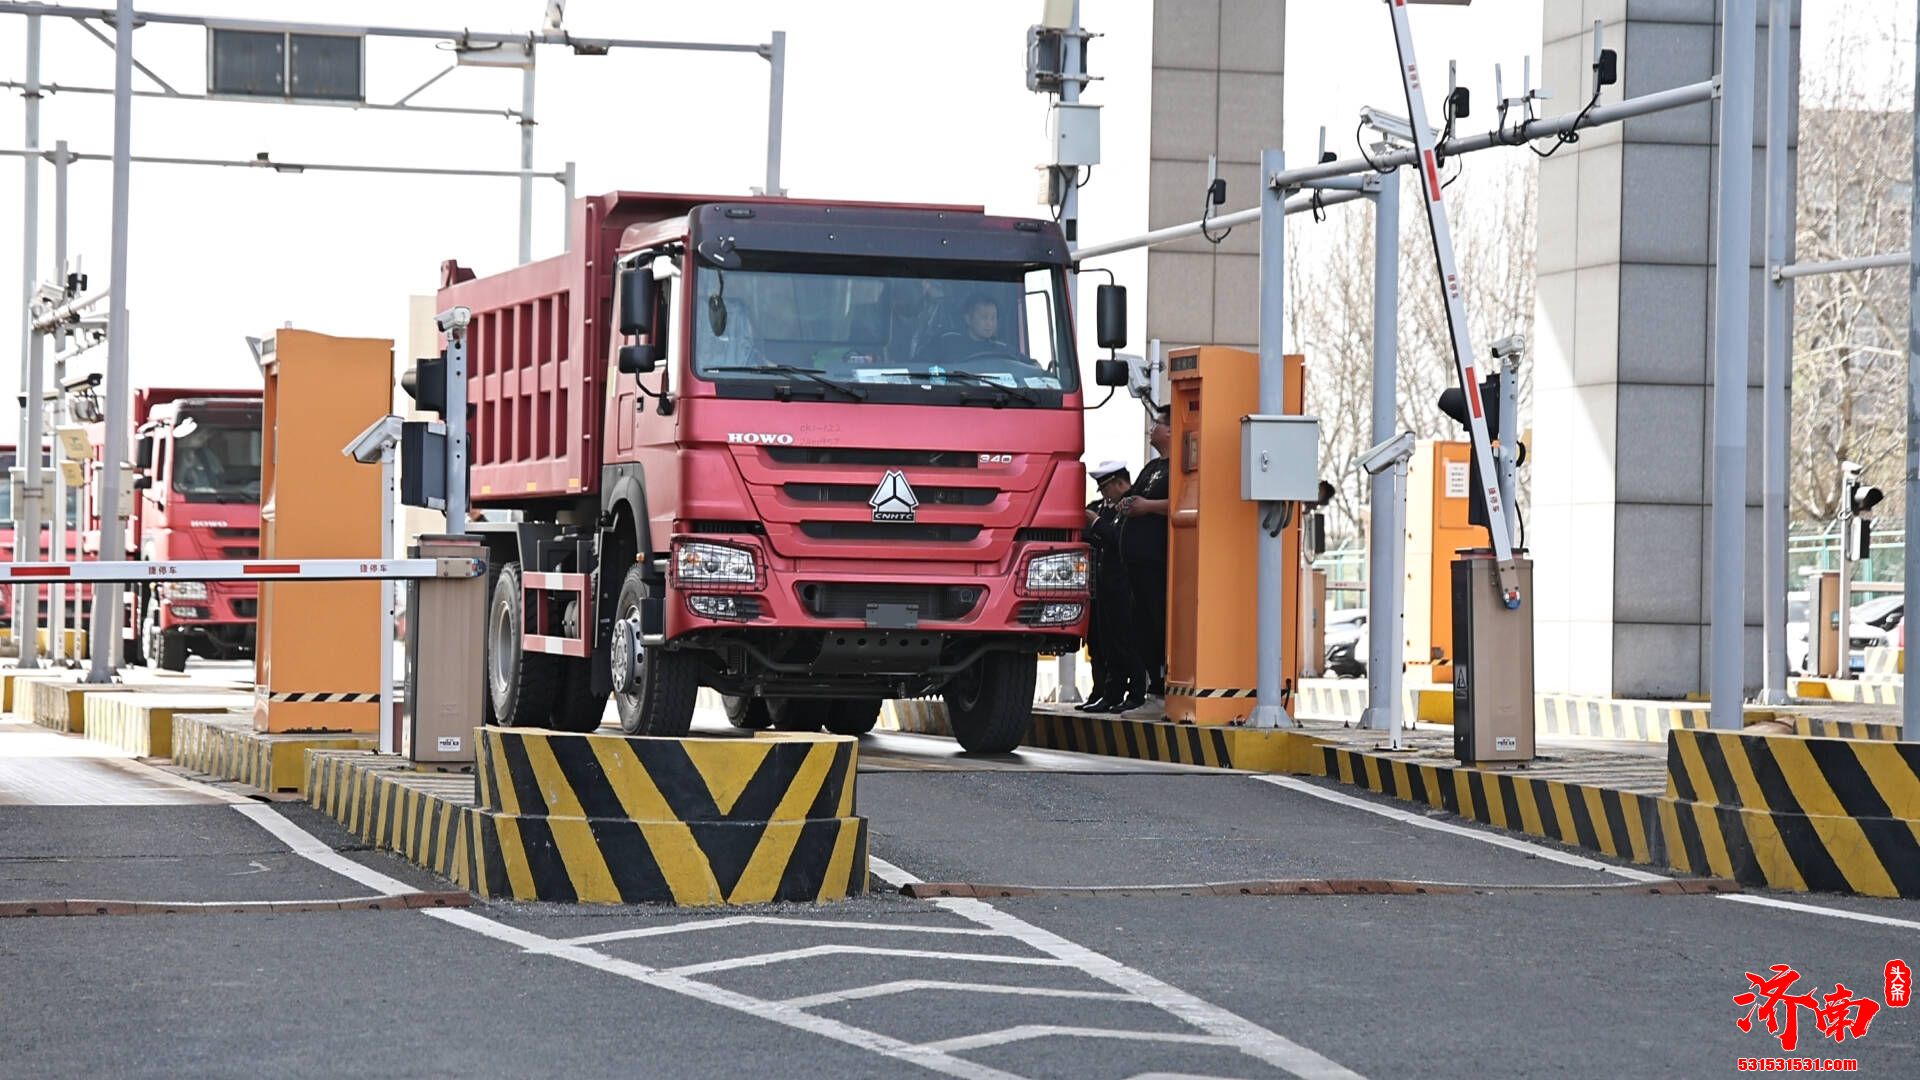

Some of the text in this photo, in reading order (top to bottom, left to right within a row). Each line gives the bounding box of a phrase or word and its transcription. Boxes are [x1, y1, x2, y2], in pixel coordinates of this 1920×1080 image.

[727, 433, 793, 444] HOWO
[979, 454, 1012, 463] 340
[875, 512, 913, 520] CNHTC
